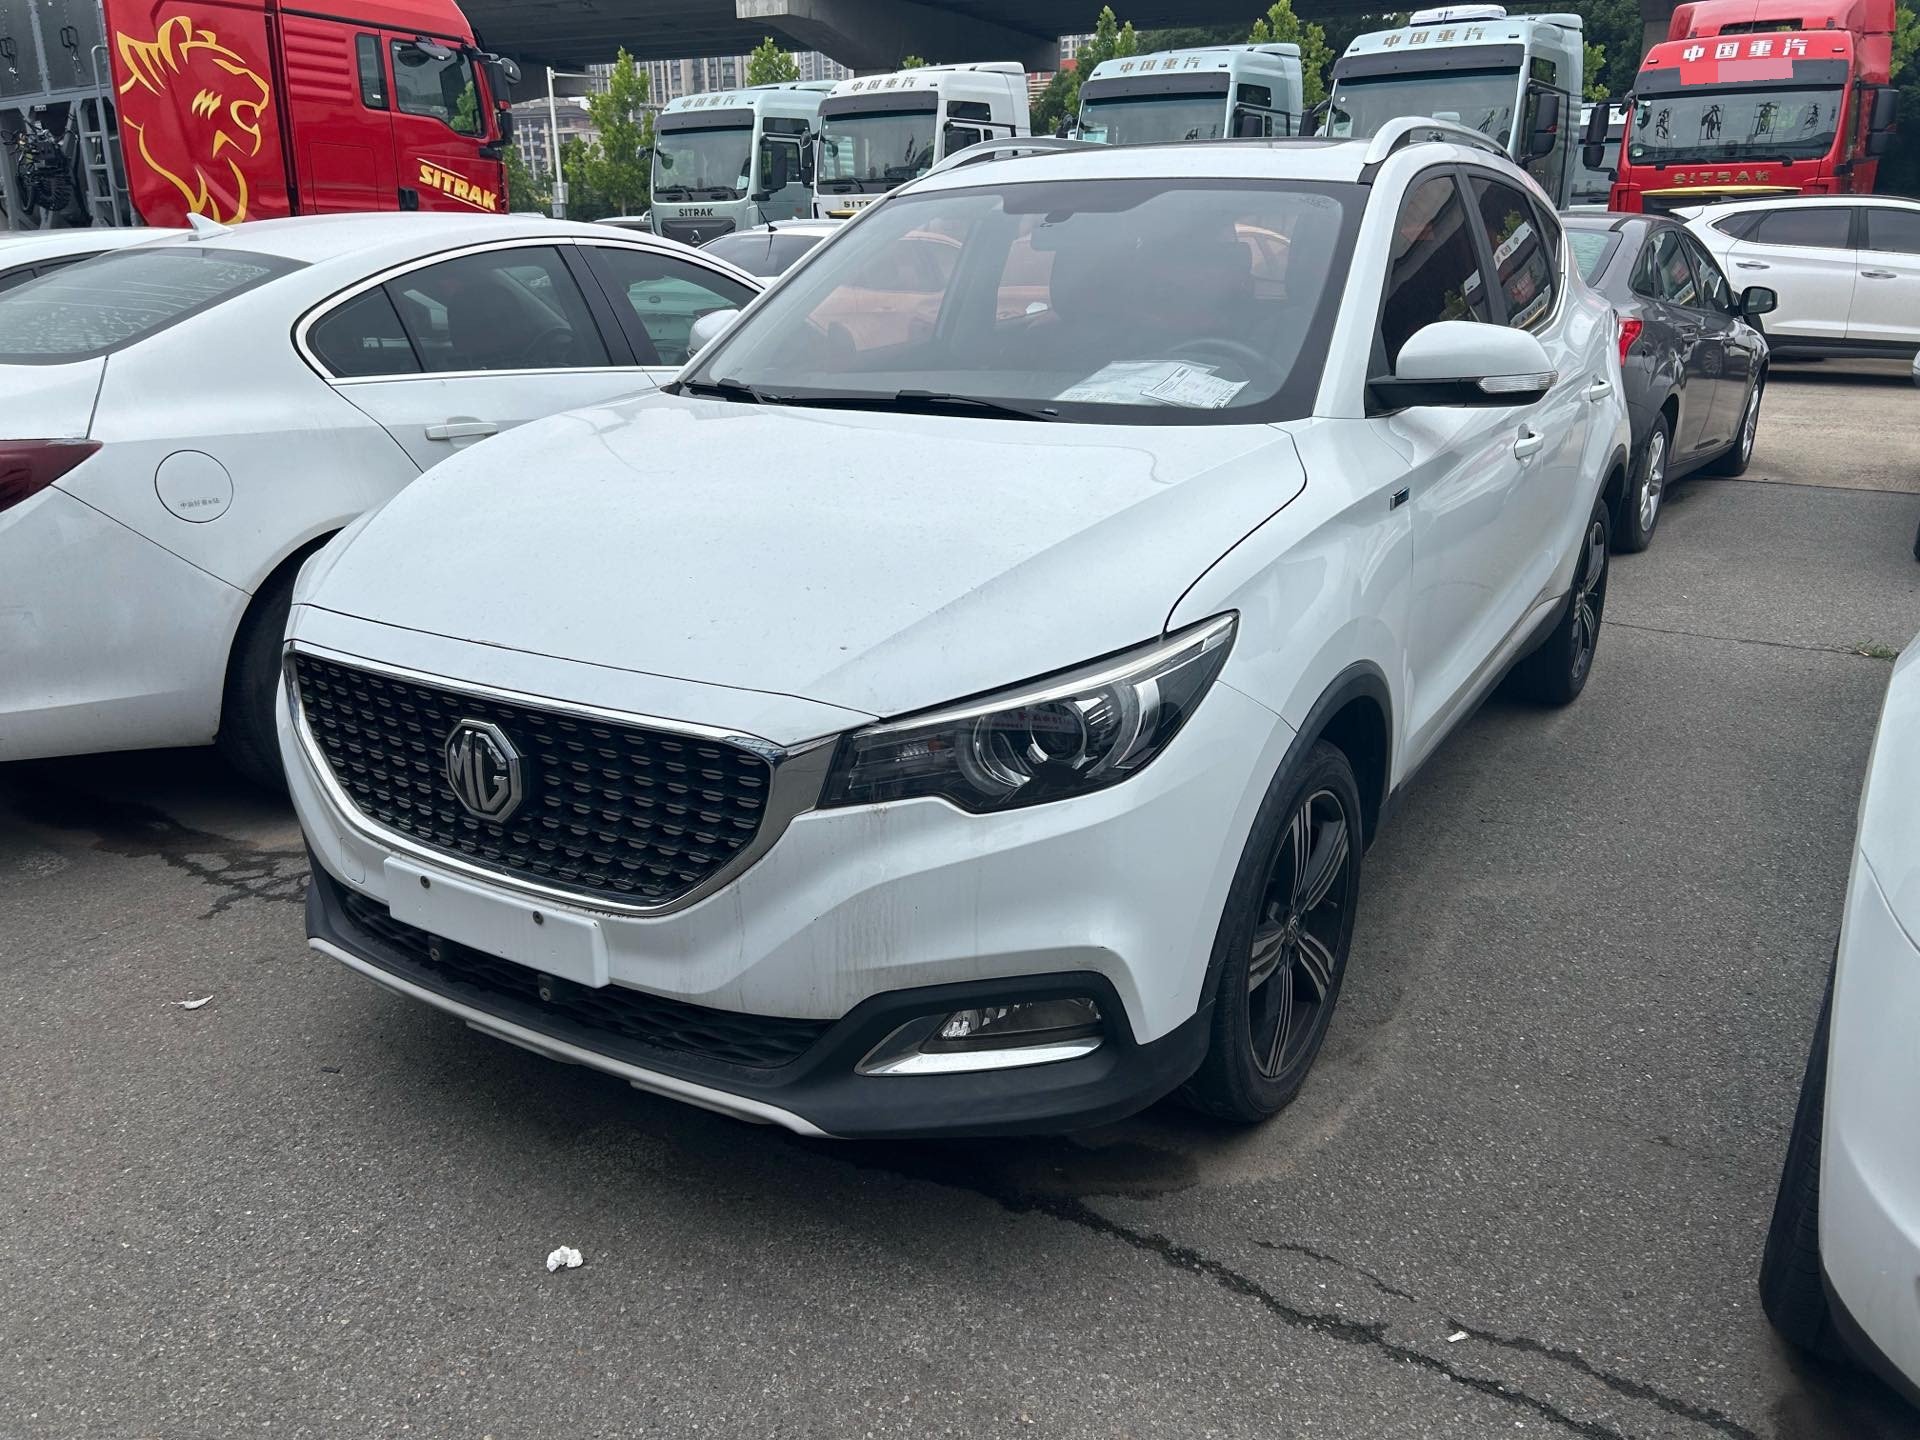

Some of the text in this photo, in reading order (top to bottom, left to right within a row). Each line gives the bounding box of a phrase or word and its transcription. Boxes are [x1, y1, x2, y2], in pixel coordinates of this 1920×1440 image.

[1383, 27, 1487, 48] 中国重汽
[1682, 38, 1808, 62] 中国重汽
[1119, 57, 1202, 73] 中国重汽
[851, 77, 917, 92] 中国重汽
[419, 164, 497, 211] SITRAK
[678, 207, 714, 217] SITRAK
[449, 729, 510, 813] MG
